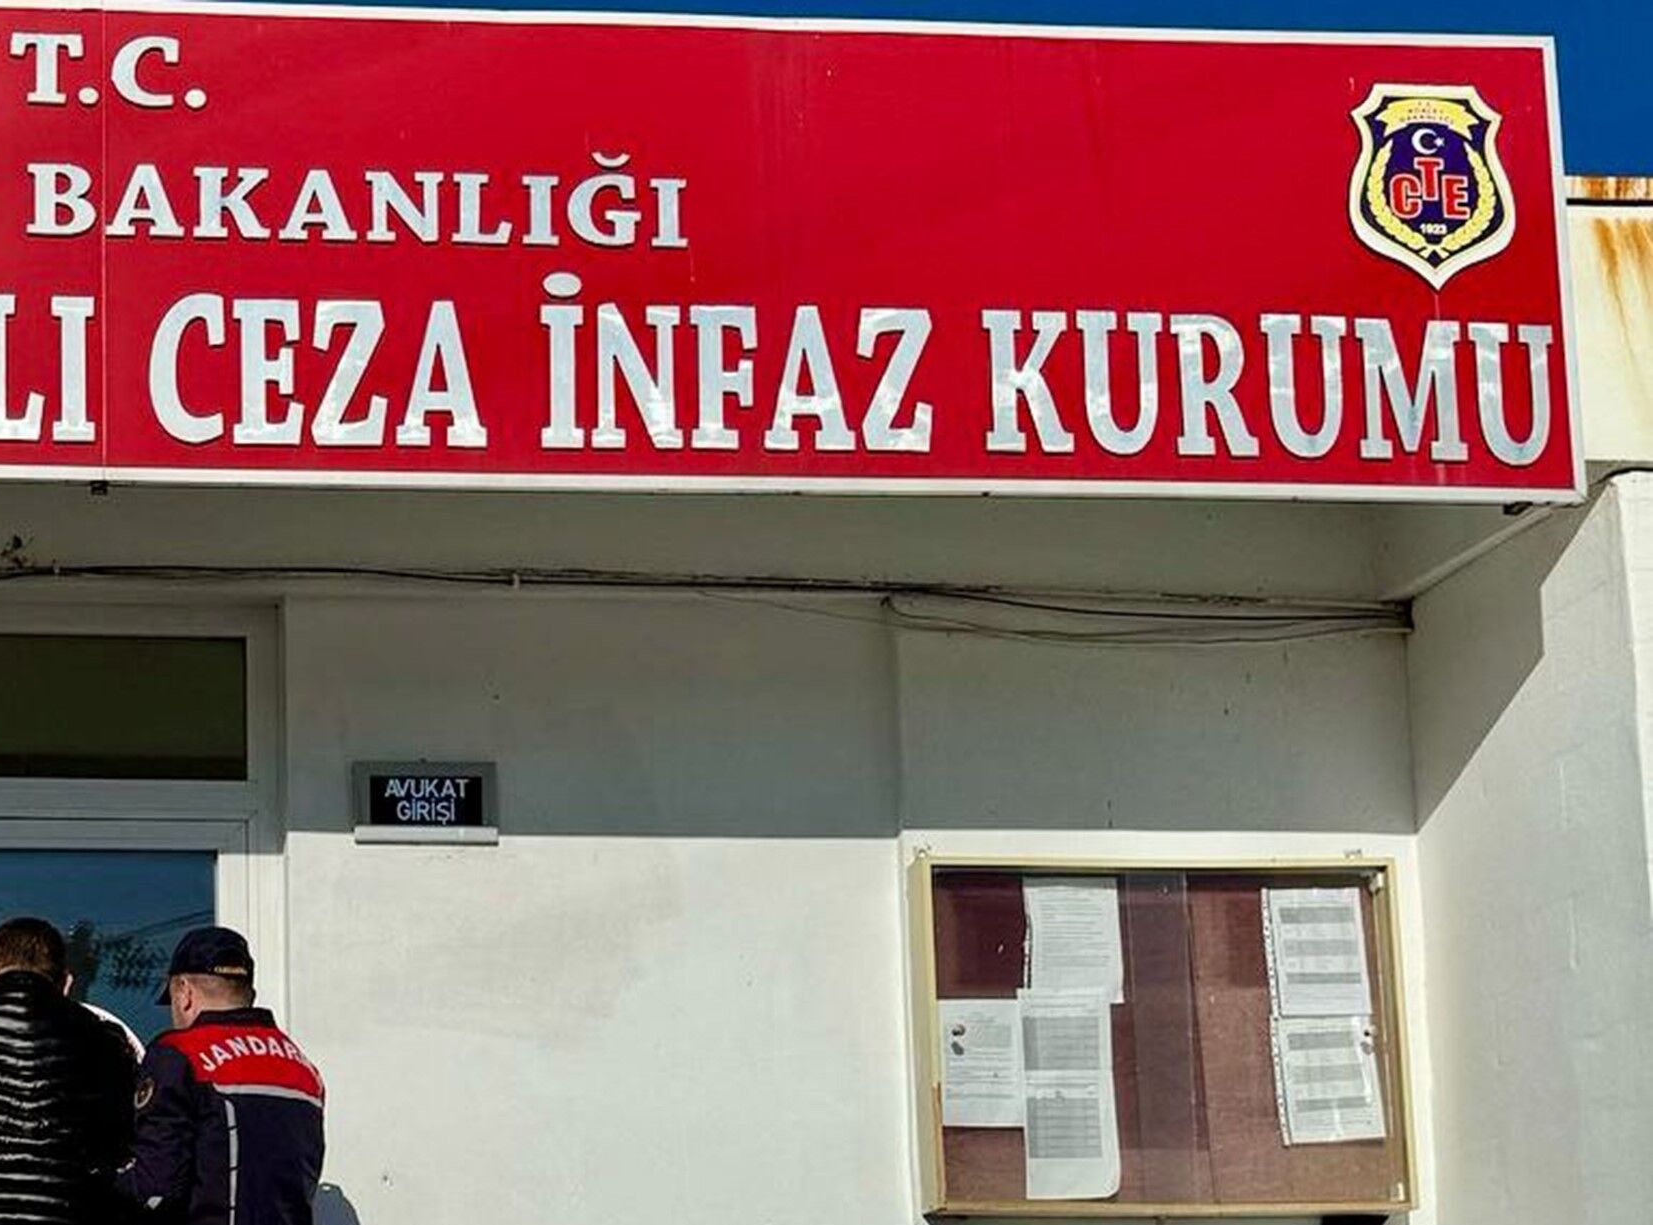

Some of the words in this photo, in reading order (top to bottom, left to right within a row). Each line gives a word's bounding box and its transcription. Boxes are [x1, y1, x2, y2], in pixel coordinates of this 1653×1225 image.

[10, 31, 208, 109] T.C.
[26, 151, 687, 248] BAKANLIĞI
[1389, 157, 1471, 219] CTE
[148, 292, 488, 448] CEZA
[539, 272, 932, 453] İNFAZ
[980, 308, 1553, 466] KURUMU
[384, 778, 469, 798] AVUKAT
[396, 798, 455, 825] GİRİŞİ
[199, 1035, 303, 1072] JANDAR
